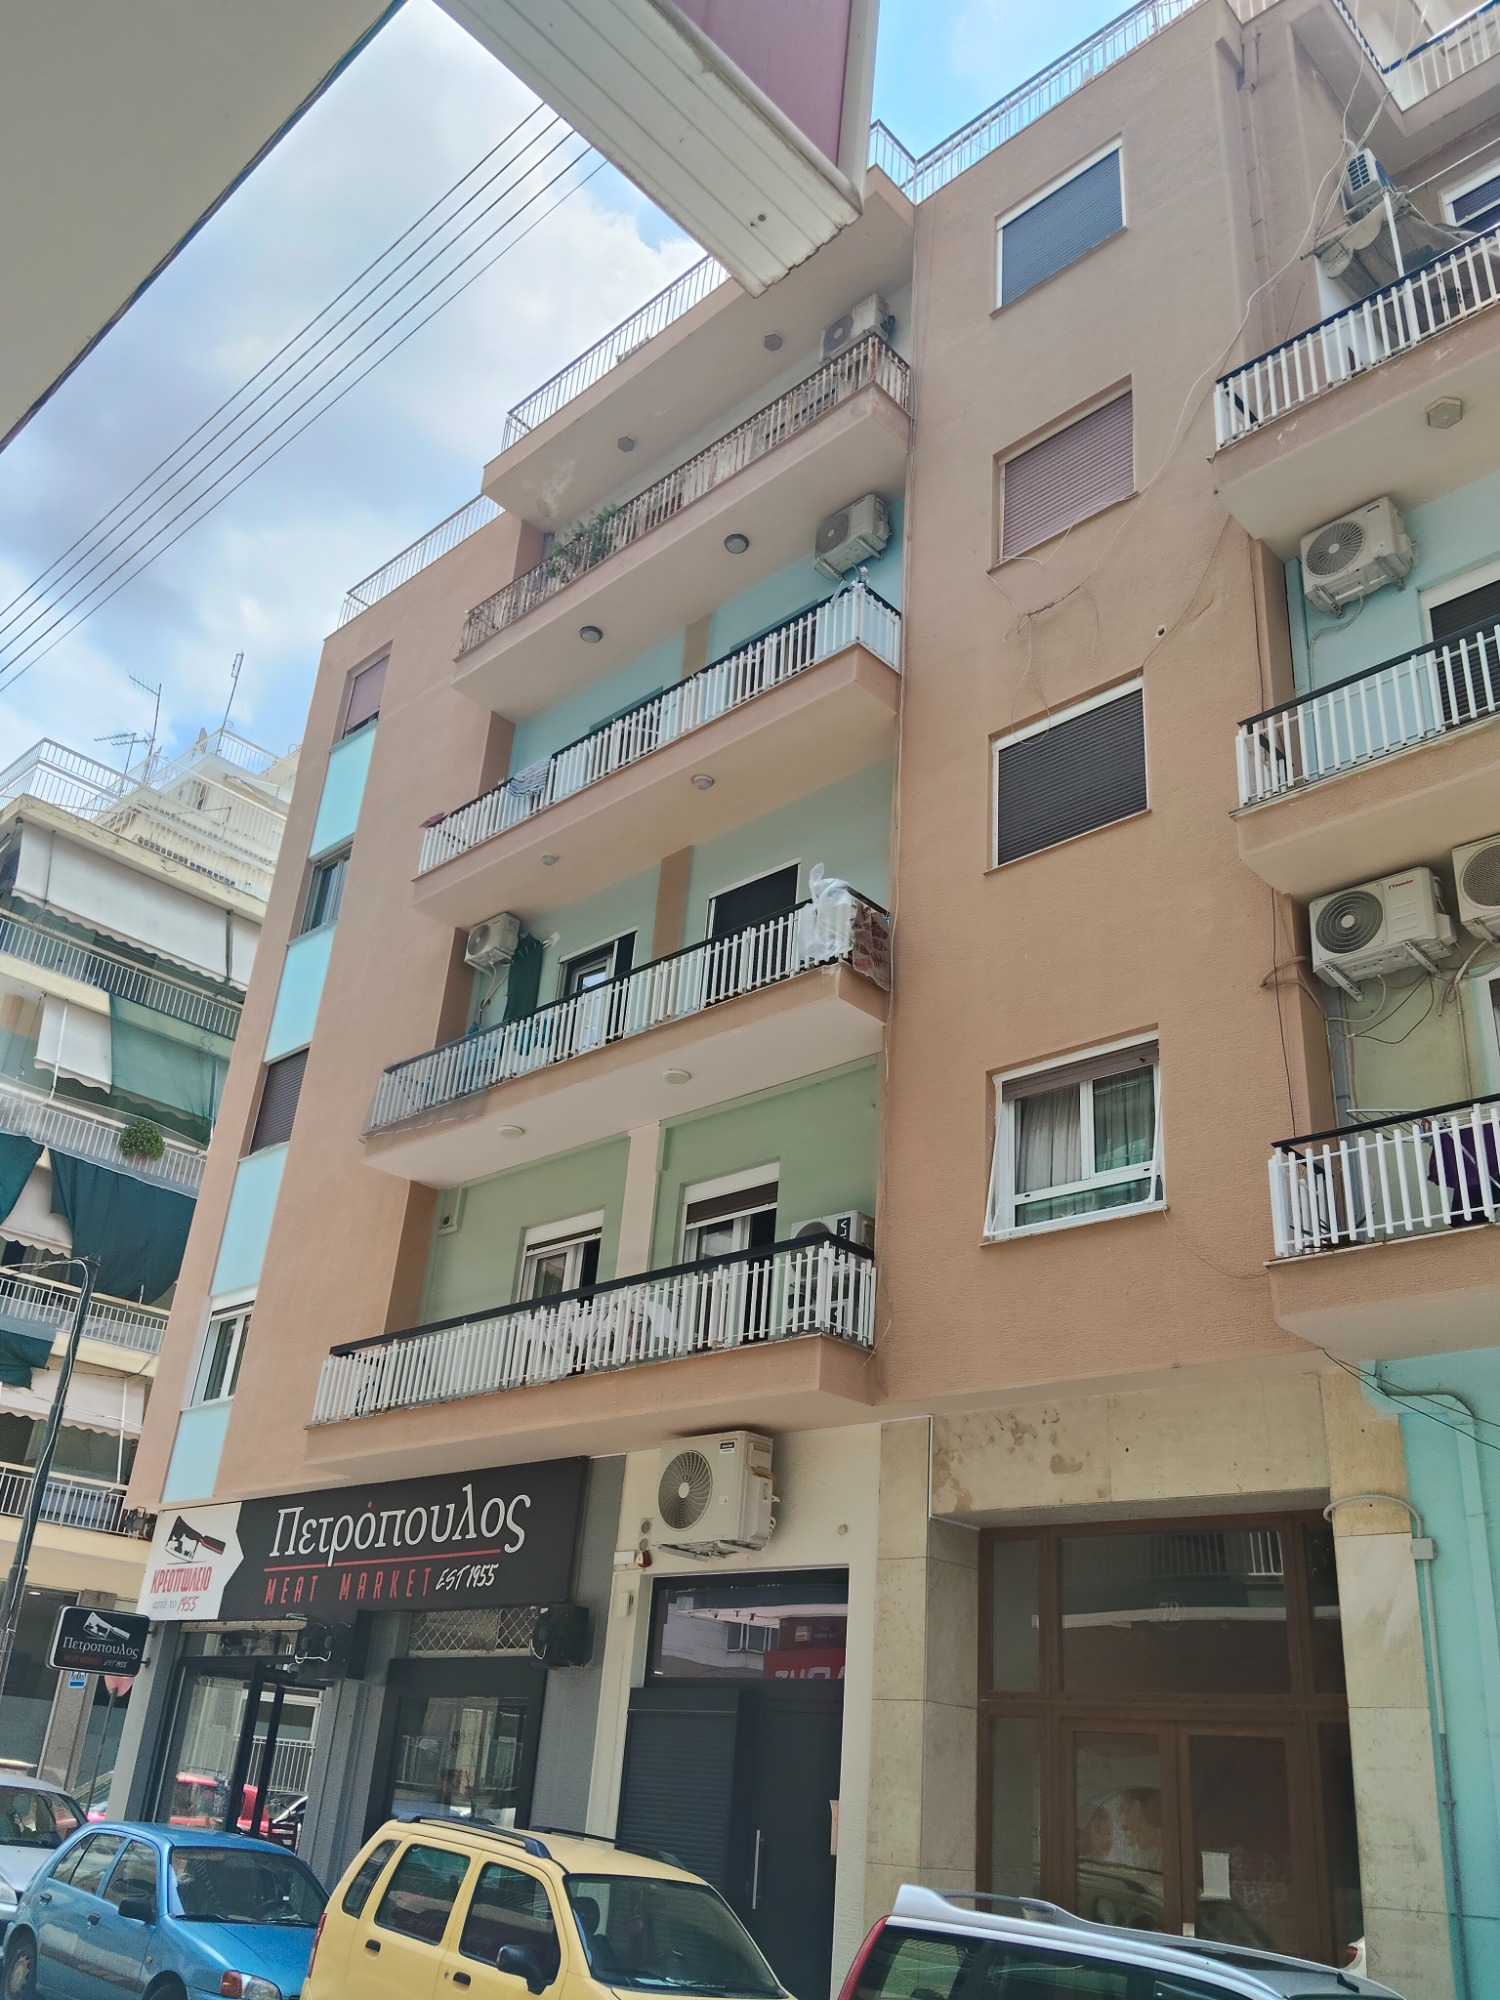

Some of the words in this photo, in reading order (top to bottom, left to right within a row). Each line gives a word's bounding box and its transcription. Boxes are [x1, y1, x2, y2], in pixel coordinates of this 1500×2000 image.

[269, 1483, 531, 1567] Πετρόπουλος
[176, 1595, 200, 1612] 1955
[264, 1575, 319, 1605] MEAT
[338, 1567, 432, 1602] MARKET
[435, 1564, 470, 1591] EST
[466, 1563, 499, 1588] 1955
